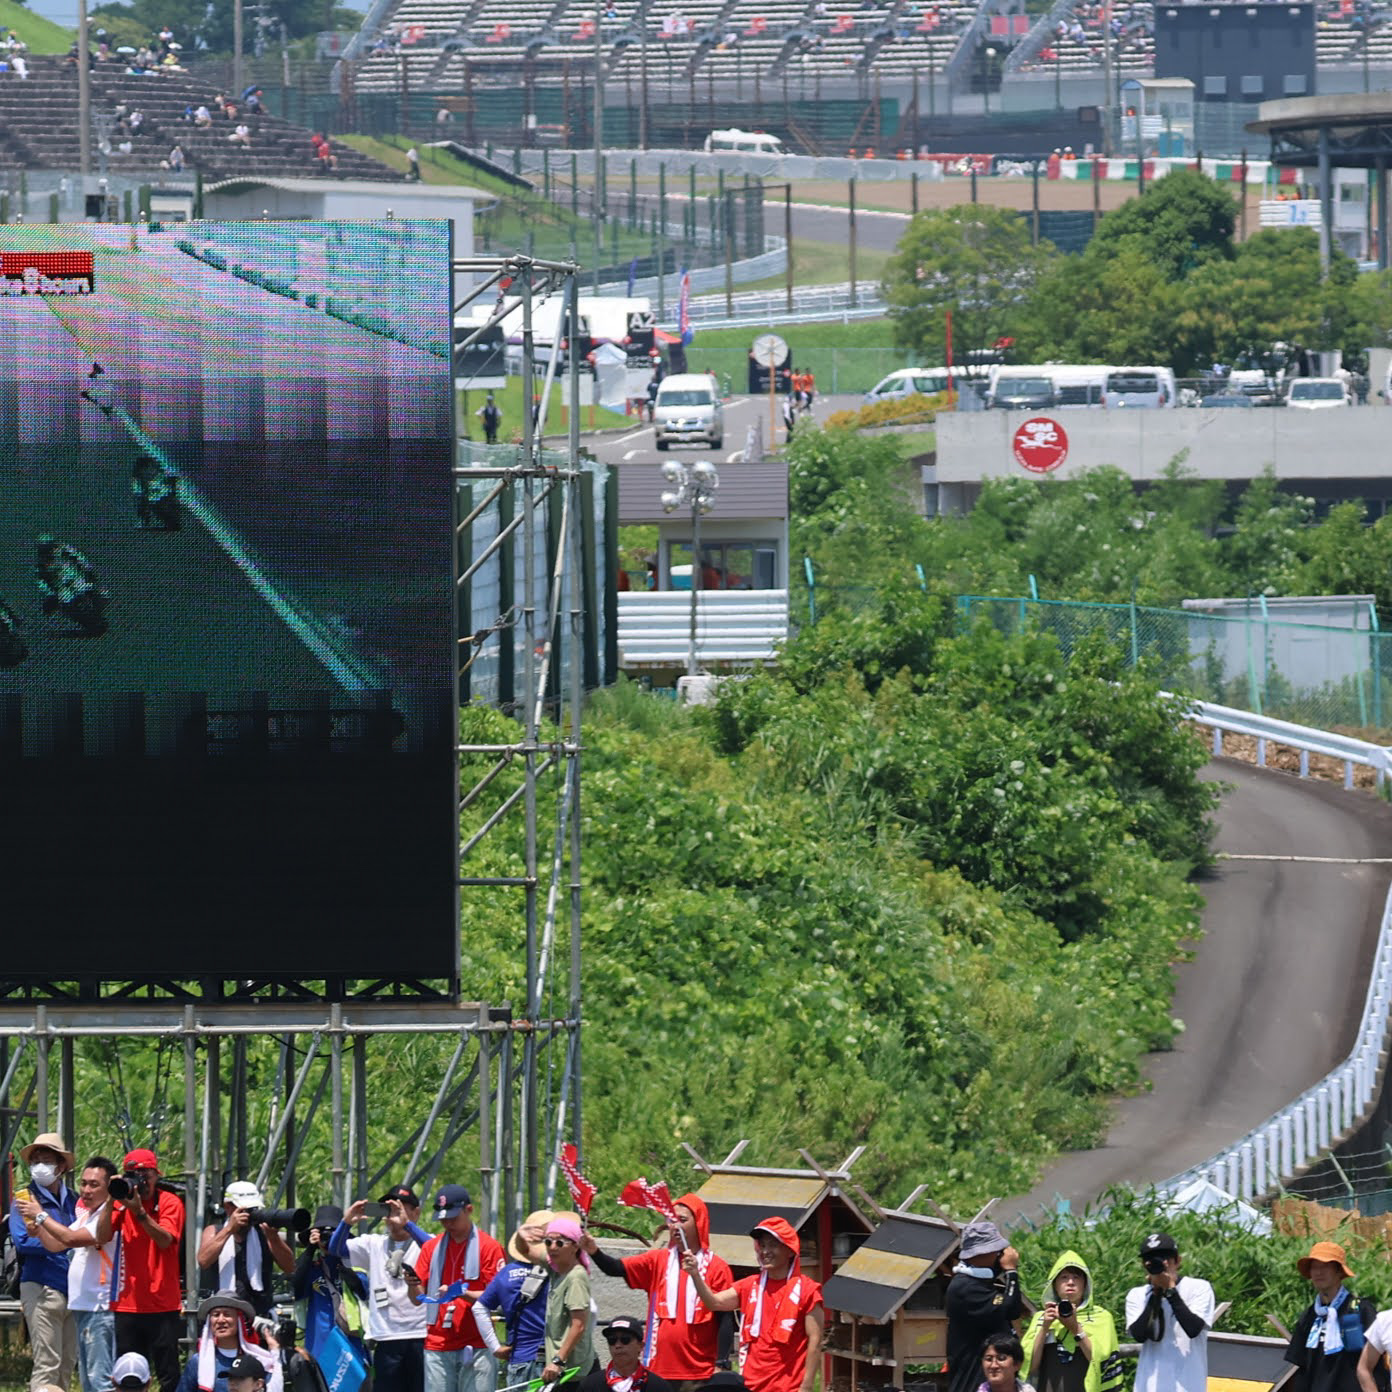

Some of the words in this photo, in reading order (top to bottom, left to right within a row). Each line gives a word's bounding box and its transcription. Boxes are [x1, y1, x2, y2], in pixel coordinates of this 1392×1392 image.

[630, 312, 656, 329] A2
[1024, 422, 1054, 433] SM
[231, 1358, 242, 1368] C
